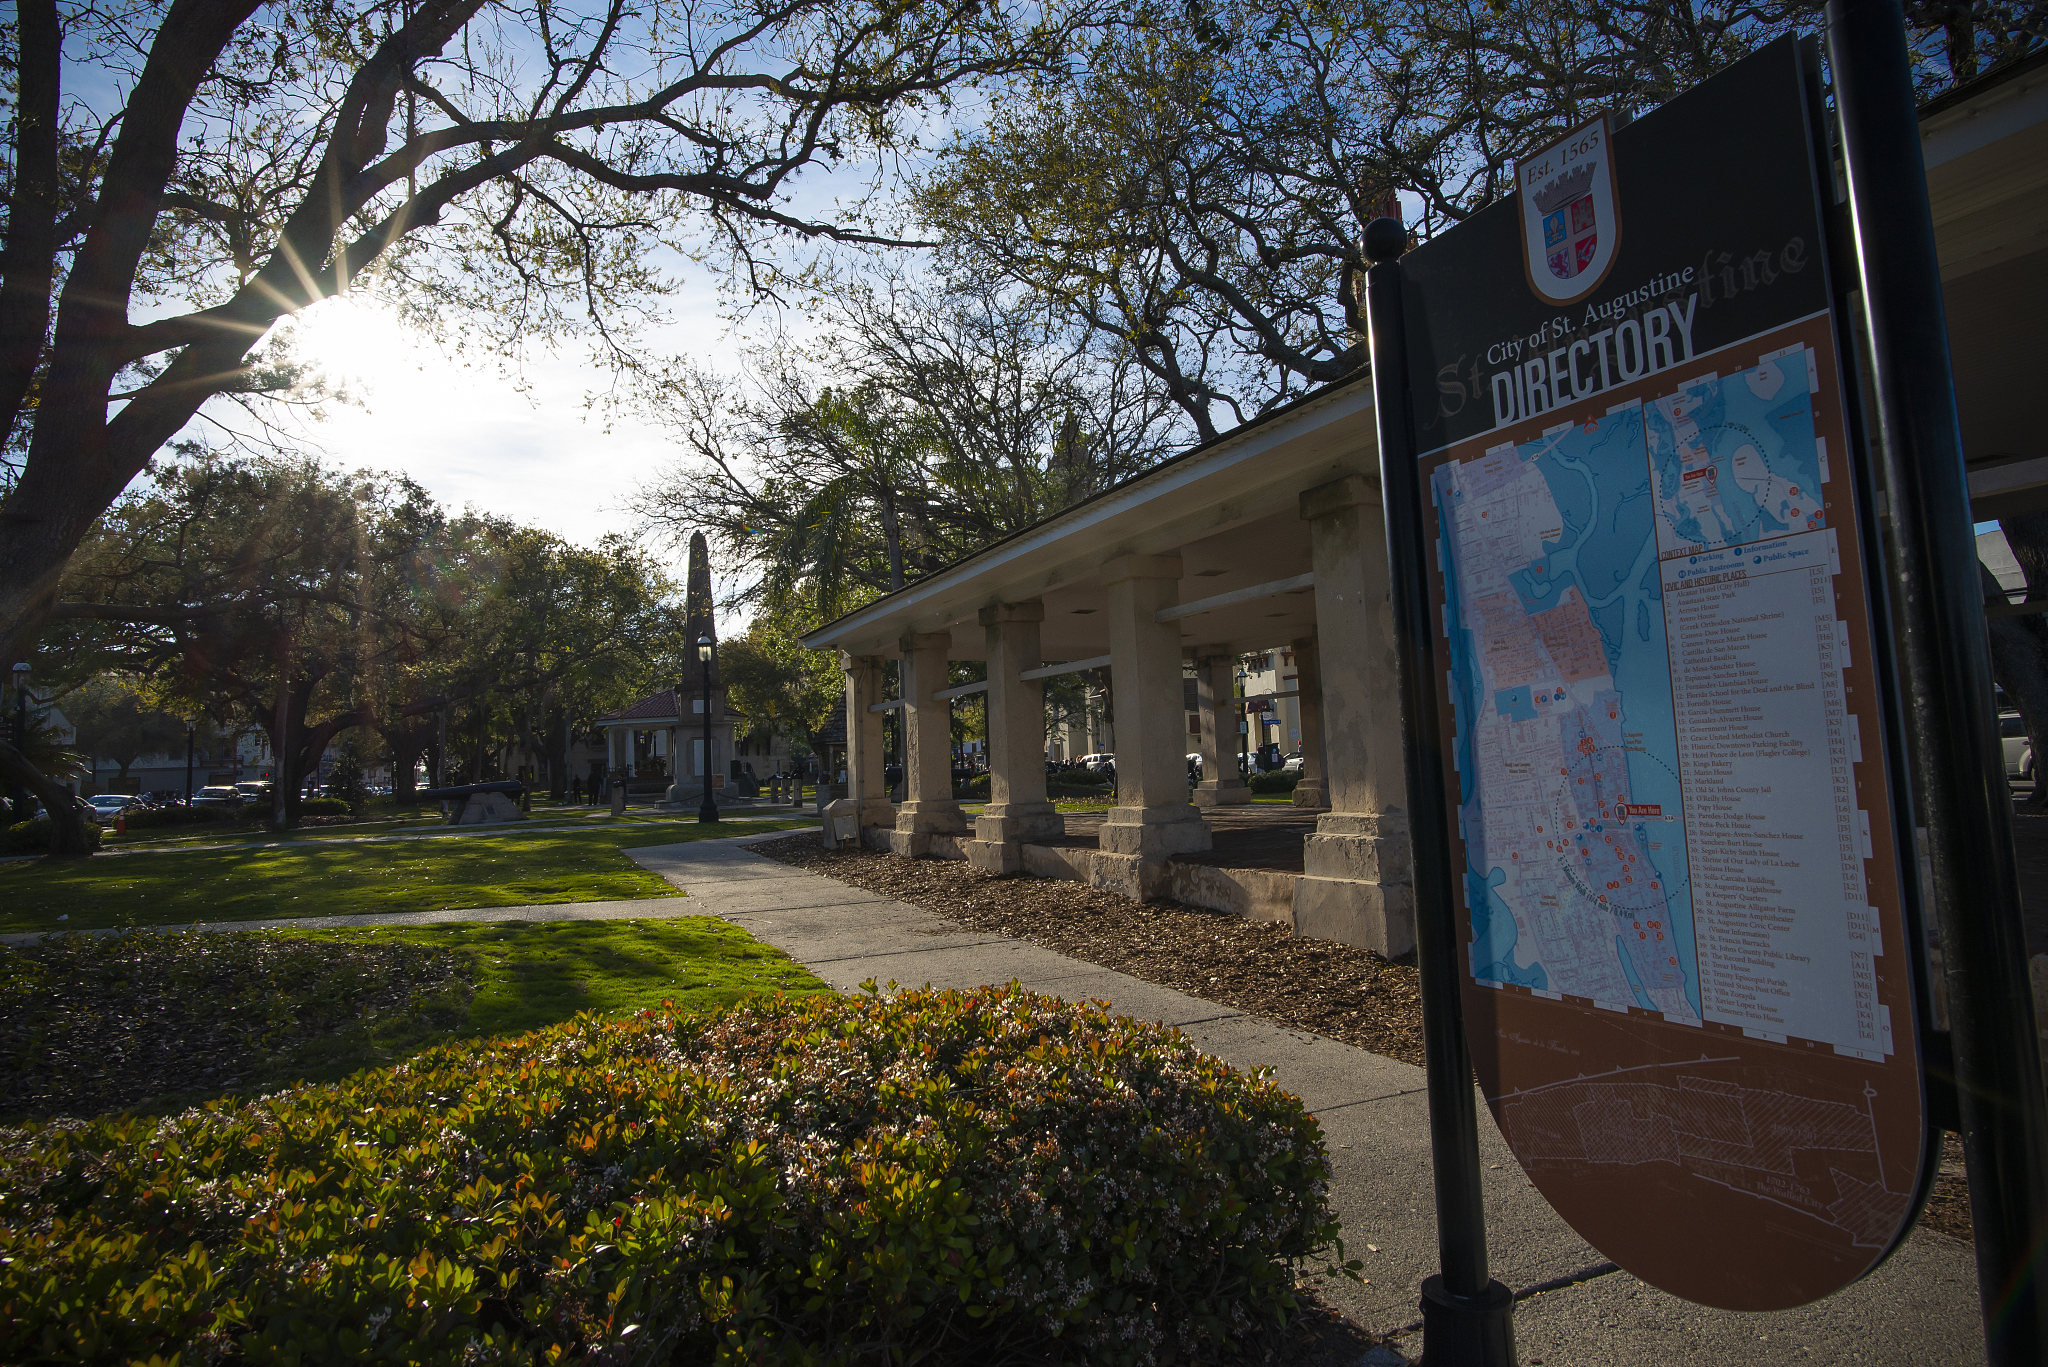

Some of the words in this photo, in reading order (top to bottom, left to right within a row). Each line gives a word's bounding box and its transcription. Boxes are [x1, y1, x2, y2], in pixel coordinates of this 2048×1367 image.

[1527, 162, 1554, 187] Est.
[1560, 130, 1599, 167] 1565
[1487, 336, 1524, 366] City
[1528, 322, 1548, 349] of
[1552, 314, 1576, 340] St.
[1584, 266, 1695, 324] Augustine
[1491, 292, 1698, 430] DIRECTORY
[1662, 548, 1687, 560] CONTEXT
[1689, 544, 1703, 554] MAP
[1744, 540, 1788, 554] Information
[1698, 552, 1724, 562] Parking
[1763, 552, 1787, 562] Public
[1788, 548, 1810, 559] Space
[1687, 566, 1708, 576] Public
[1709, 561, 1745, 573] Restrooms
[1665, 580, 1679, 592] CIVIC
[1680, 578, 1693, 590] AND
[1694, 574, 1721, 587] HISTORIC
[1723, 570, 1747, 582] PLACES
[1676, 588, 1697, 597] Alcazar
[1699, 585, 1715, 593] Hotel
[1716, 582, 1731, 592] (City
[1733, 579, 1749, 590] Hall)
[1677, 596, 1704, 605] Anastasia
[1721, 591, 1735, 599] Park
[1700, 602, 1719, 610] House
[1679, 622, 1698, 632] (Greek
[1700, 618, 1730, 628] Orthodox
[1731, 614, 1758, 624] National
[1759, 610, 1784, 622] Shrine)
[1681, 647, 1704, 656] Castillo
[1726, 642, 1749, 651] Marcos
[1682, 655, 1711, 664] Cathedral
[1713, 652, 1736, 661] Basilica
[1752, 740, 1777, 749] Parking
[1778, 739, 1803, 748] Facility
[1755, 749, 1780, 758] (Flagler
[1781, 748, 1810, 757] College)
[1711, 759, 1732, 768] Bakery
[1735, 786, 1759, 794] County
[1760, 786, 1771, 794] Jail
[1628, 807, 1637, 815] You
[1638, 806, 1647, 814] Are
[1648, 806, 1660, 815] Here
[1745, 858, 1760, 867] Lady
[1713, 882, 1744, 893] Augustine
[1746, 885, 1782, 896] Lighthouse
[1738, 893, 1767, 904] Quarters
[1715, 900, 1746, 911] Augustine
[1748, 903, 1776, 914] Alligator
[1777, 906, 1795, 914] Farm
[1717, 918, 1748, 929] Augustine
[1749, 921, 1765, 929] Civic
[1767, 923, 1789, 932] Center
[1708, 925, 1730, 936] (Visitor
[1731, 928, 1770, 940] Information)
[1719, 944, 1736, 954] Johns
[1737, 946, 1761, 957] County
[1763, 950, 1783, 959] Public
[1785, 952, 1810, 964] Library
[1723, 953, 1745, 963] Record
[1747, 956, 1775, 968] Building
[1713, 970, 1732, 980] Trinity
[1735, 973, 1765, 985] Episcopal
[1766, 977, 1787, 987] Parish
[1713, 978, 1734, 988] United
[1735, 982, 1753, 991] States
[1755, 985, 1768, 993] Post
[1770, 987, 1790, 996] Office
[1766, 1175, 1811, 1195] 1702-1763
[1757, 1182, 1772, 1193] The
[1774, 1186, 1802, 1203] Walled
[1805, 1195, 1824, 1210] City
